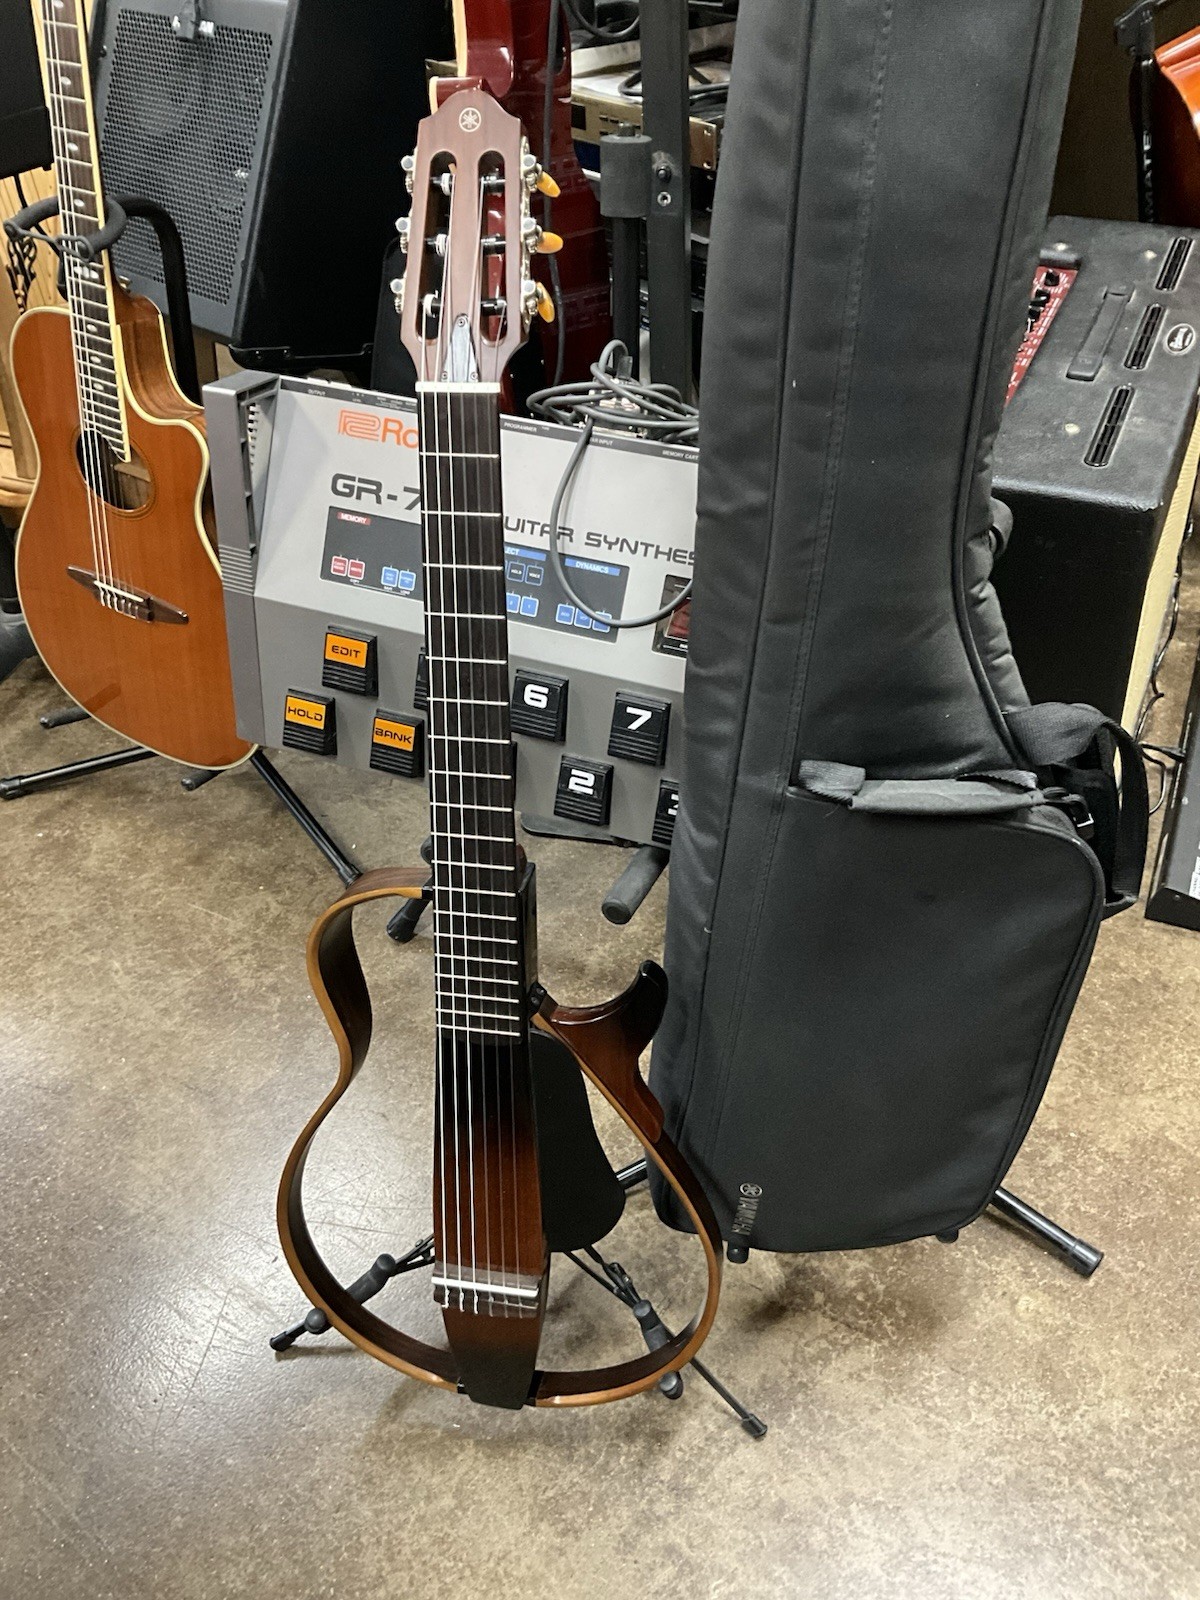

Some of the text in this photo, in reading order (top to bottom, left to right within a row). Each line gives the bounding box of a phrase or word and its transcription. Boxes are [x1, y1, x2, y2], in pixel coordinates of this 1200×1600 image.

[504, 421, 537, 432] PROGRAMMER
[662, 449, 684, 459] MEMORY
[340, 512, 367, 524] MEMORY
[575, 561, 609, 574] DYNAMICS
[331, 645, 361, 659] EDIT
[523, 683, 550, 709] 6
[287, 706, 323, 722] HOLD
[625, 706, 652, 731] 7
[375, 727, 413, 745] BANK
[568, 768, 595, 796] 2
[731, 1196, 760, 1236] YAMAHA
